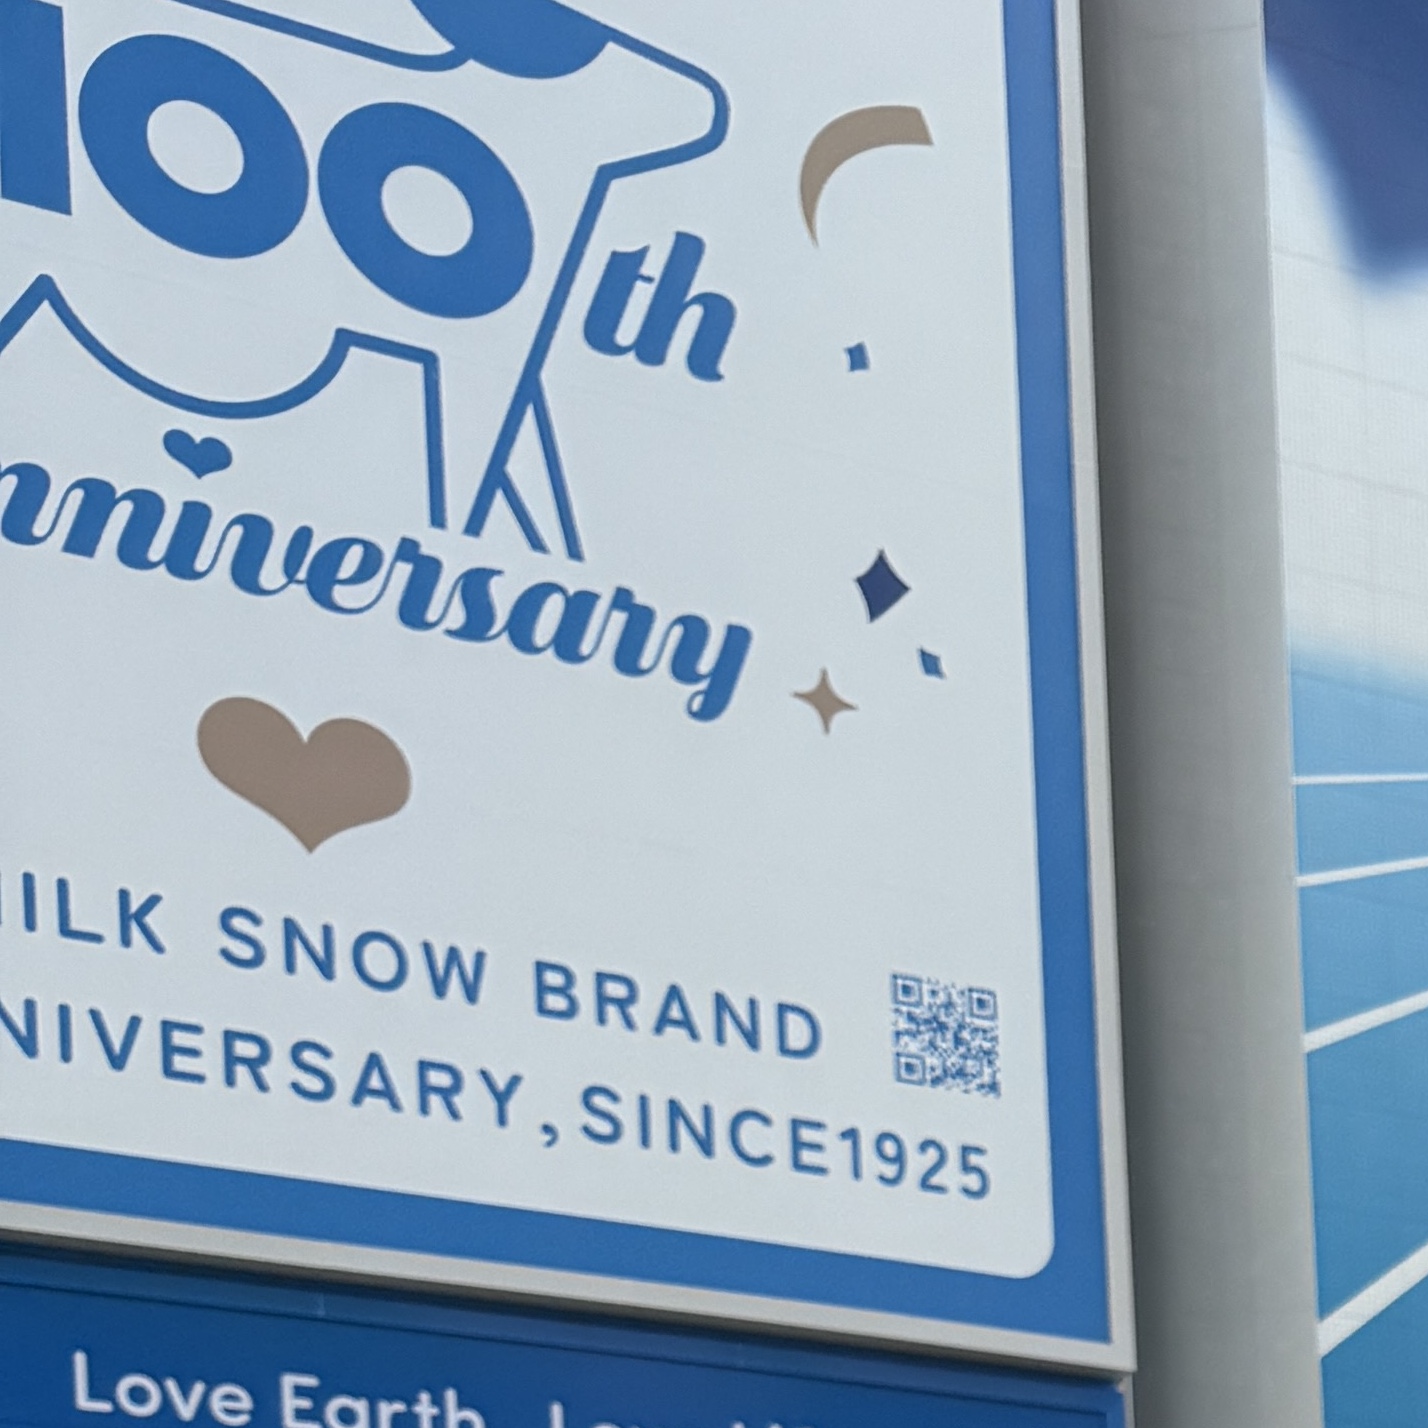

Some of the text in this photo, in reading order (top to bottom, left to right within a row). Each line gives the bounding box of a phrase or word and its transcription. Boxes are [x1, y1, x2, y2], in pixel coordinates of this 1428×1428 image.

[219, 906, 487, 1005] SNOW
[535, 959, 824, 1060] BRAND
[73, 1349, 254, 1427] Love
